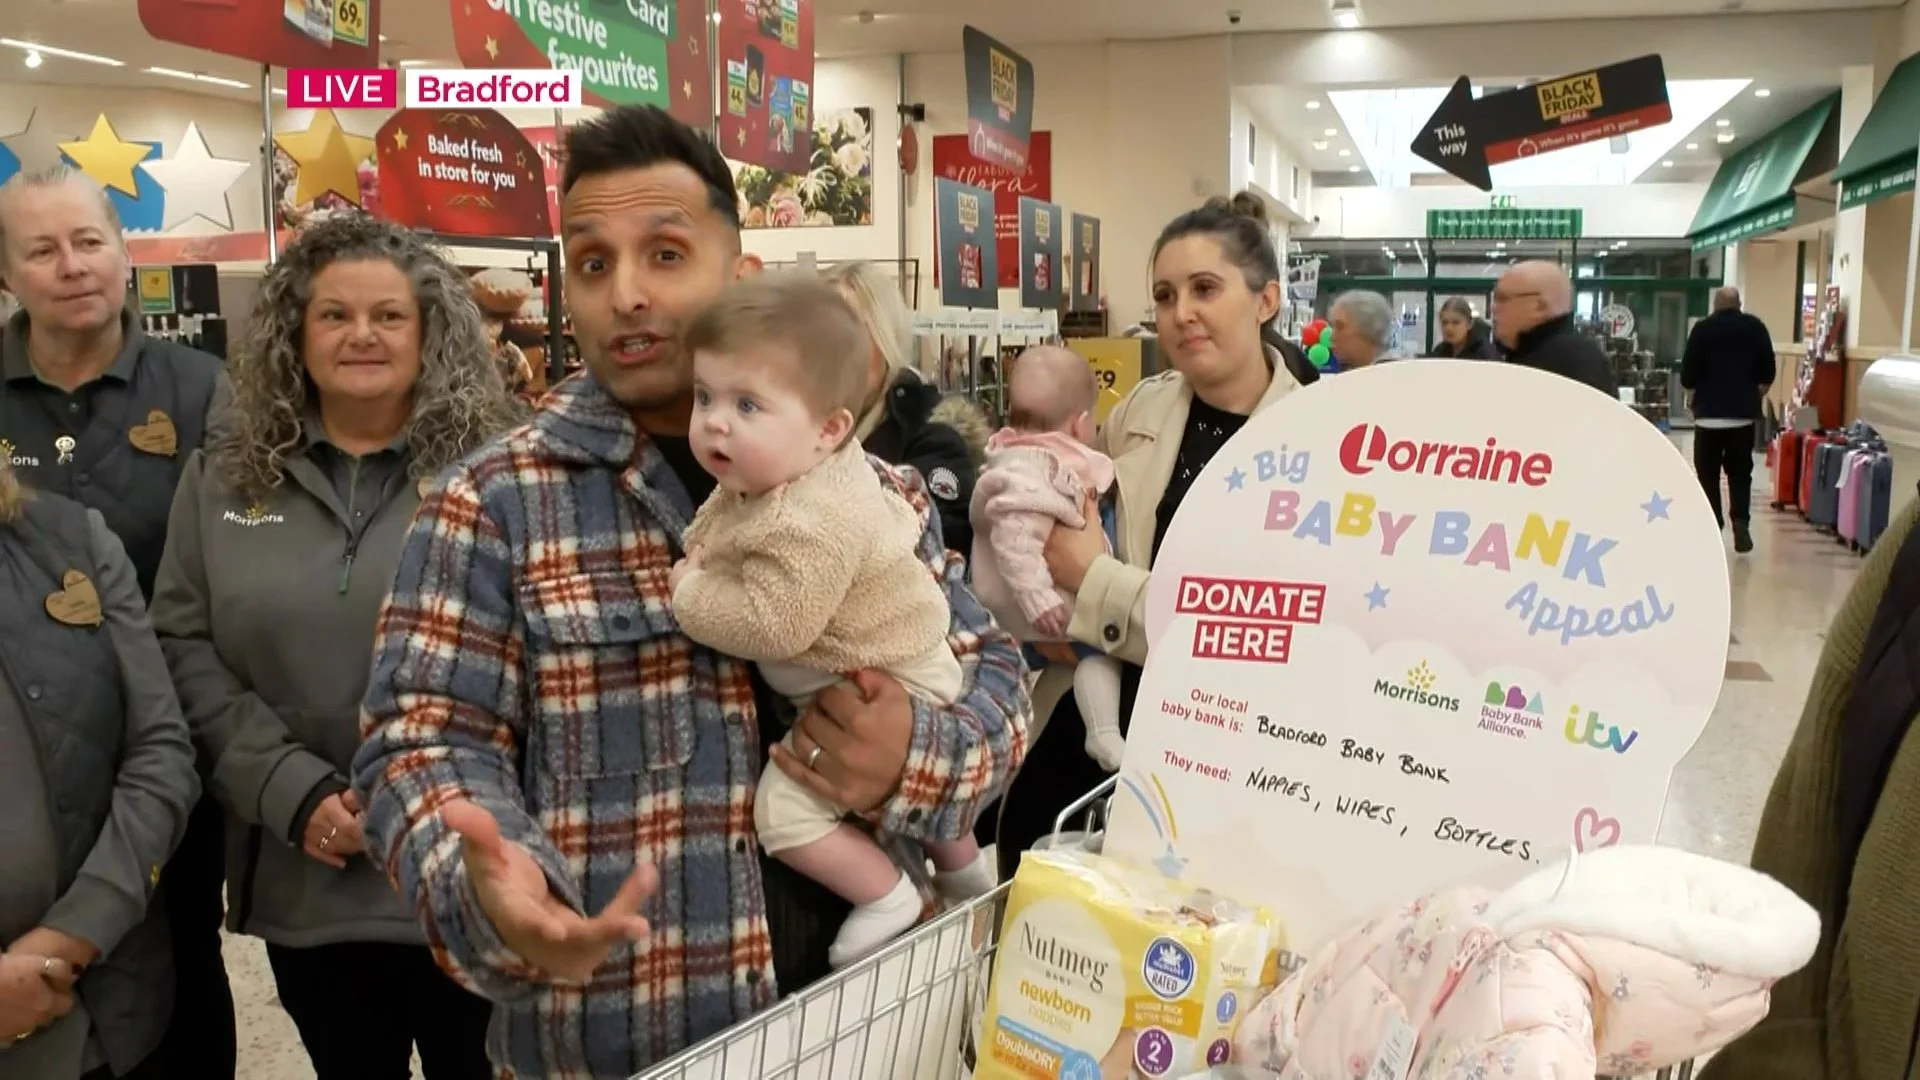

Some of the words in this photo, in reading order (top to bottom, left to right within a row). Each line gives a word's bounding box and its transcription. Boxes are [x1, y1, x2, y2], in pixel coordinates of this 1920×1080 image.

[526, 0, 608, 49] festive
[626, 0, 669, 35] Card
[547, 37, 659, 92] favourites
[992, 54, 1015, 83] BLACK
[1540, 77, 1594, 101] BLACK
[1543, 90, 1597, 116] FRIDAY
[427, 134, 469, 158] Baked
[471, 139, 503, 163] fresh
[1433, 123, 1466, 143] This
[1439, 140, 1468, 157] way
[418, 157, 432, 176] in
[435, 162, 469, 182] store
[471, 162, 490, 184] for
[492, 171, 516, 191] you
[1253, 444, 1311, 483] Big
[1339, 423, 1553, 488] Lorraine
[1264, 489, 1417, 556] BABY
[1428, 510, 1619, 588] BANK
[1181, 581, 1322, 618] DONATE
[1504, 581, 1675, 646] Appeal
[1197, 625, 1288, 658] HERE
[1190, 688, 1214, 705] Our
[1217, 694, 1249, 713] local
[1373, 679, 1460, 712] Morrisons
[1160, 700, 1192, 721] baby
[1194, 709, 1225, 729] bank
[1228, 716, 1244, 733] is:
[1477, 718, 1527, 740] Alliance.
[1480, 705, 1512, 725] Baby
[1512, 712, 1544, 730] Bank
[1564, 704, 1638, 755] itv
[1164, 750, 1192, 772] They
[1195, 758, 1231, 783] need:
[1340, 738, 1385, 765] BABY
[1399, 754, 1450, 784] BANK
[1019, 921, 1109, 994] Nutmeg
[1151, 972, 1178, 992] RATED
[1019, 978, 1092, 1023] newborn
[995, 1031, 1057, 1071] DoubleDRY
[1147, 1040, 1162, 1063] 2
[1213, 1046, 1224, 1061] 2
